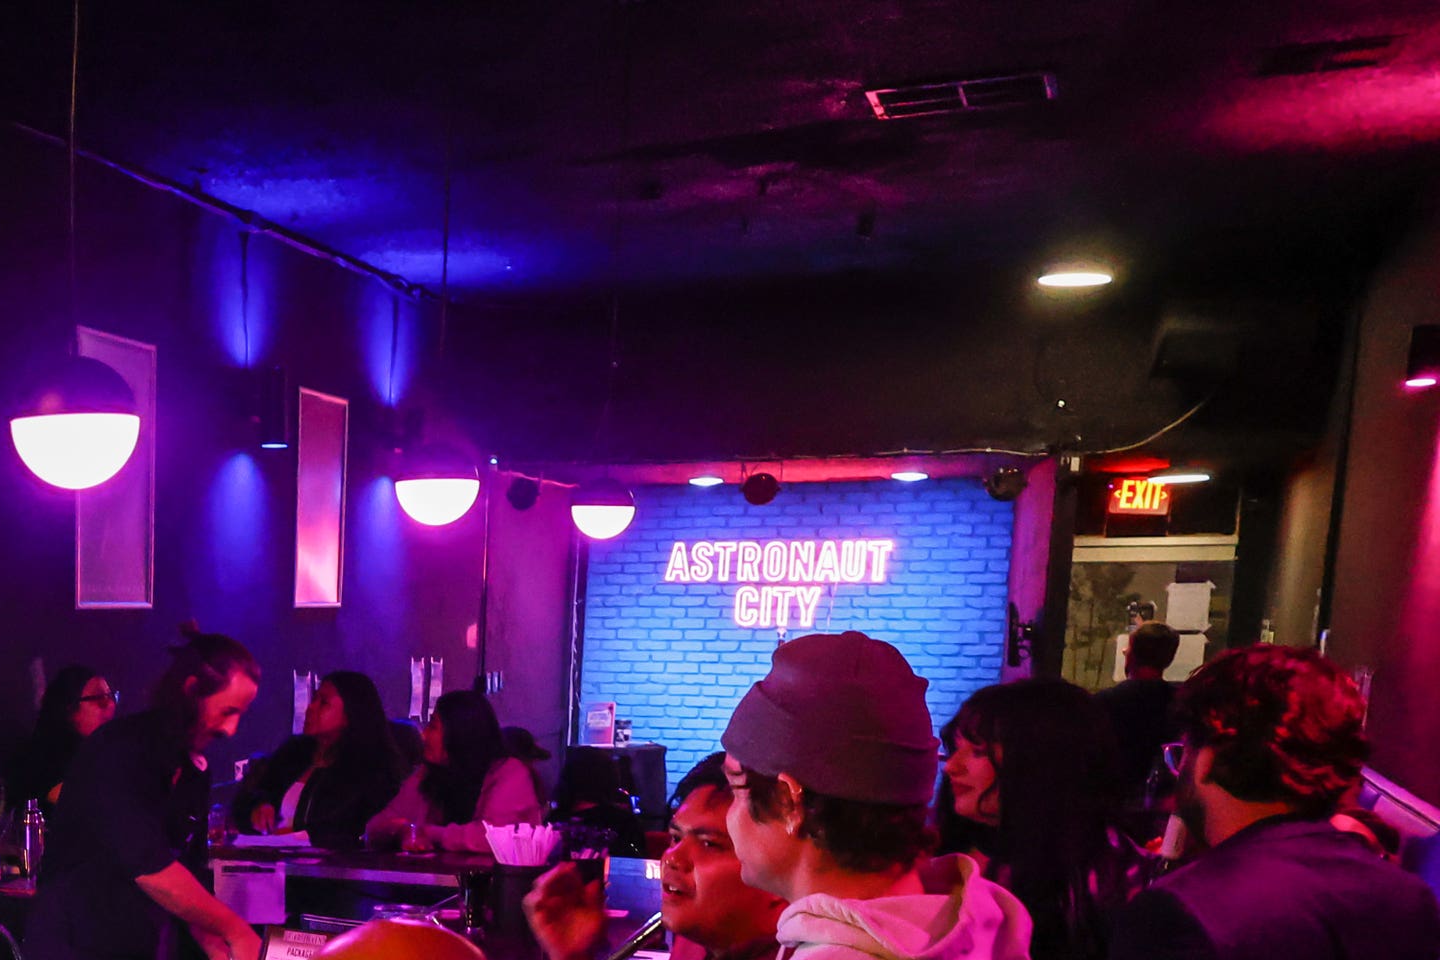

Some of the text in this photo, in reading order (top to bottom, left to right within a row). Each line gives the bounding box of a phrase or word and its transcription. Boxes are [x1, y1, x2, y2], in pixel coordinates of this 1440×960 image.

[1119, 479, 1166, 510] EXIT
[664, 539, 894, 583] ASTRONAUT
[734, 585, 823, 627] CITY
